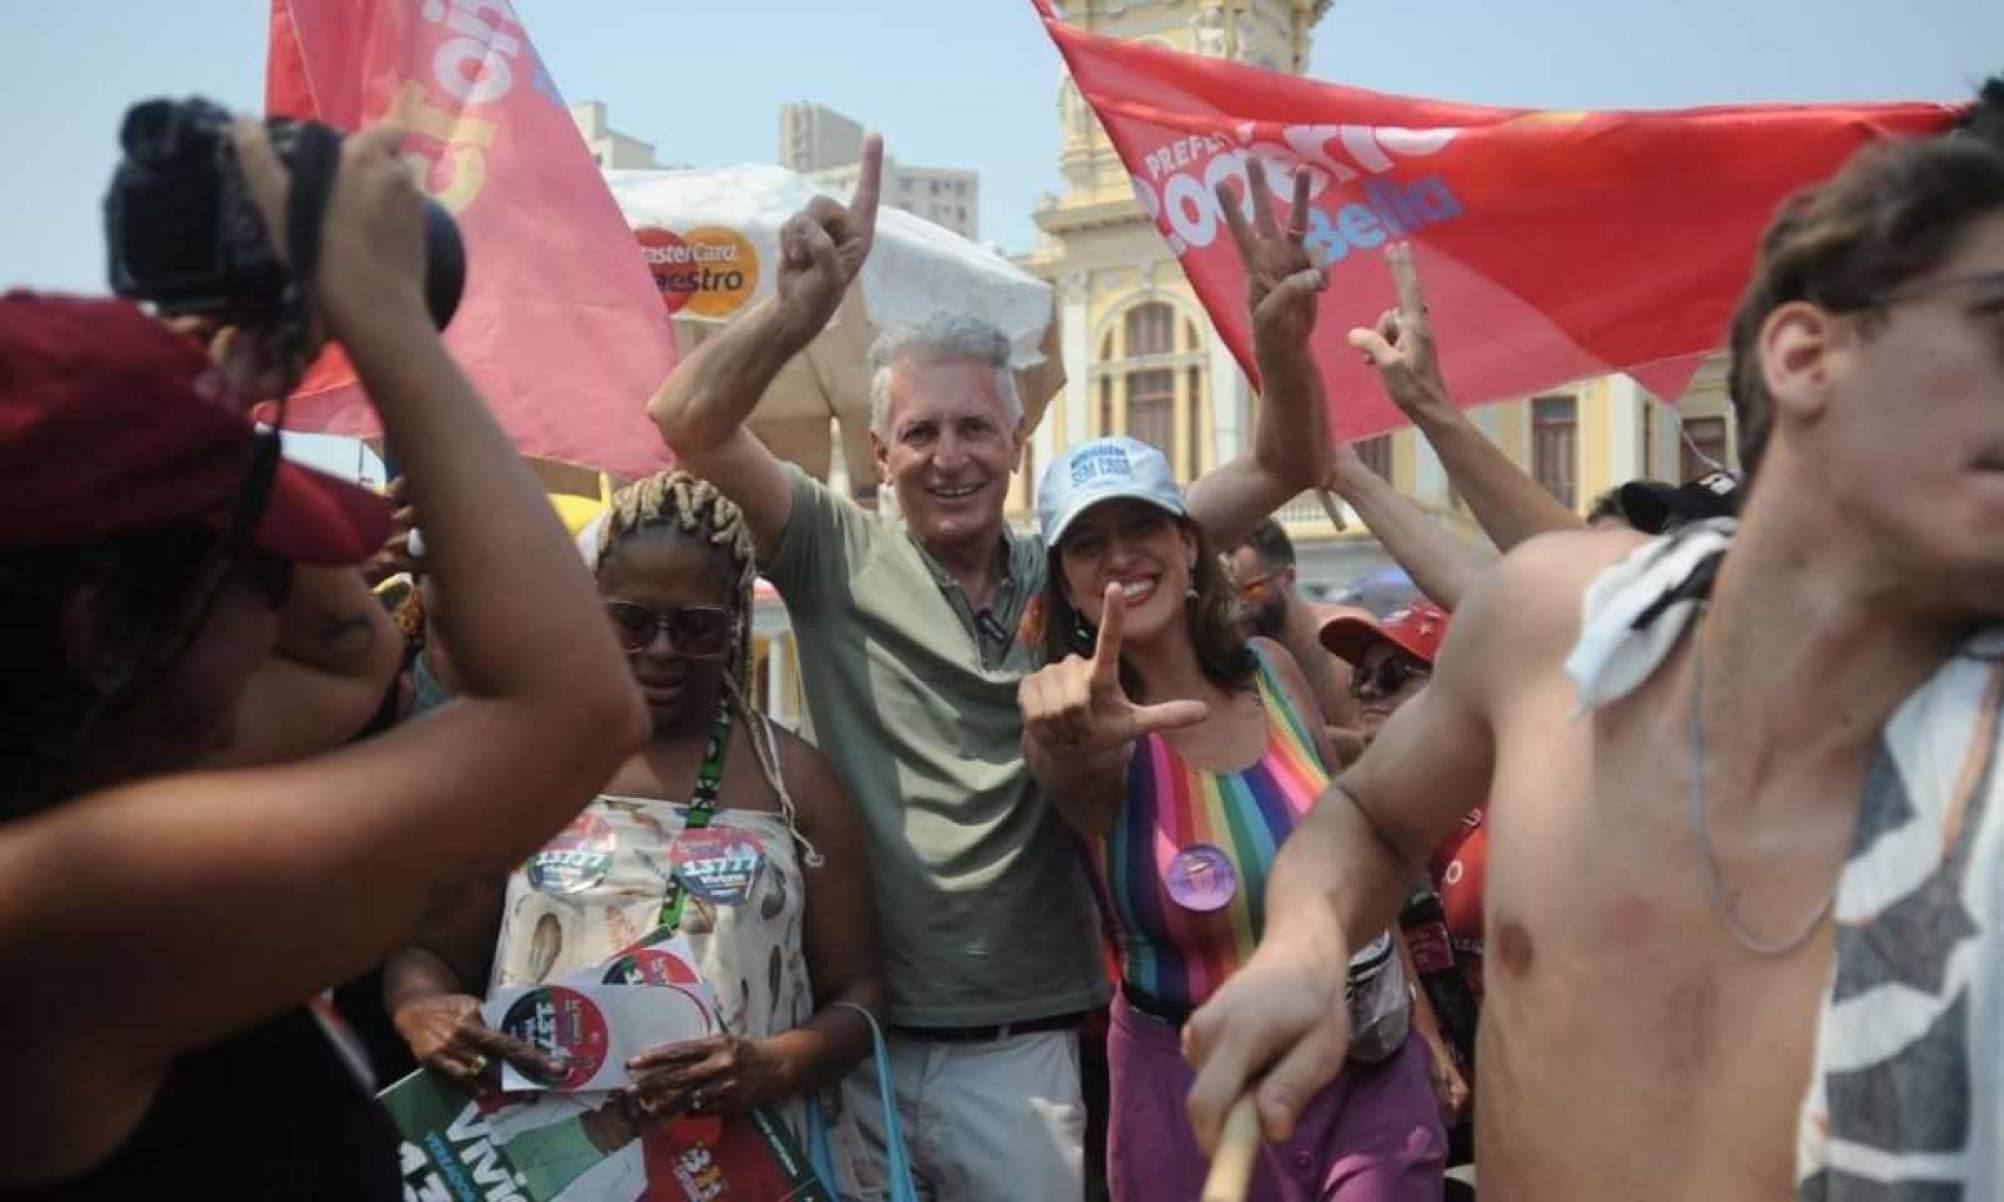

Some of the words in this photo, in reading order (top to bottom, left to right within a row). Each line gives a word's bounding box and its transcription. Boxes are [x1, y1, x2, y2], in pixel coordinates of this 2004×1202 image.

[1305, 173, 1463, 264] Bella
[640, 241, 736, 262] asterCard
[655, 267, 744, 292] aestro
[446, 1099, 528, 1202] Vivi
